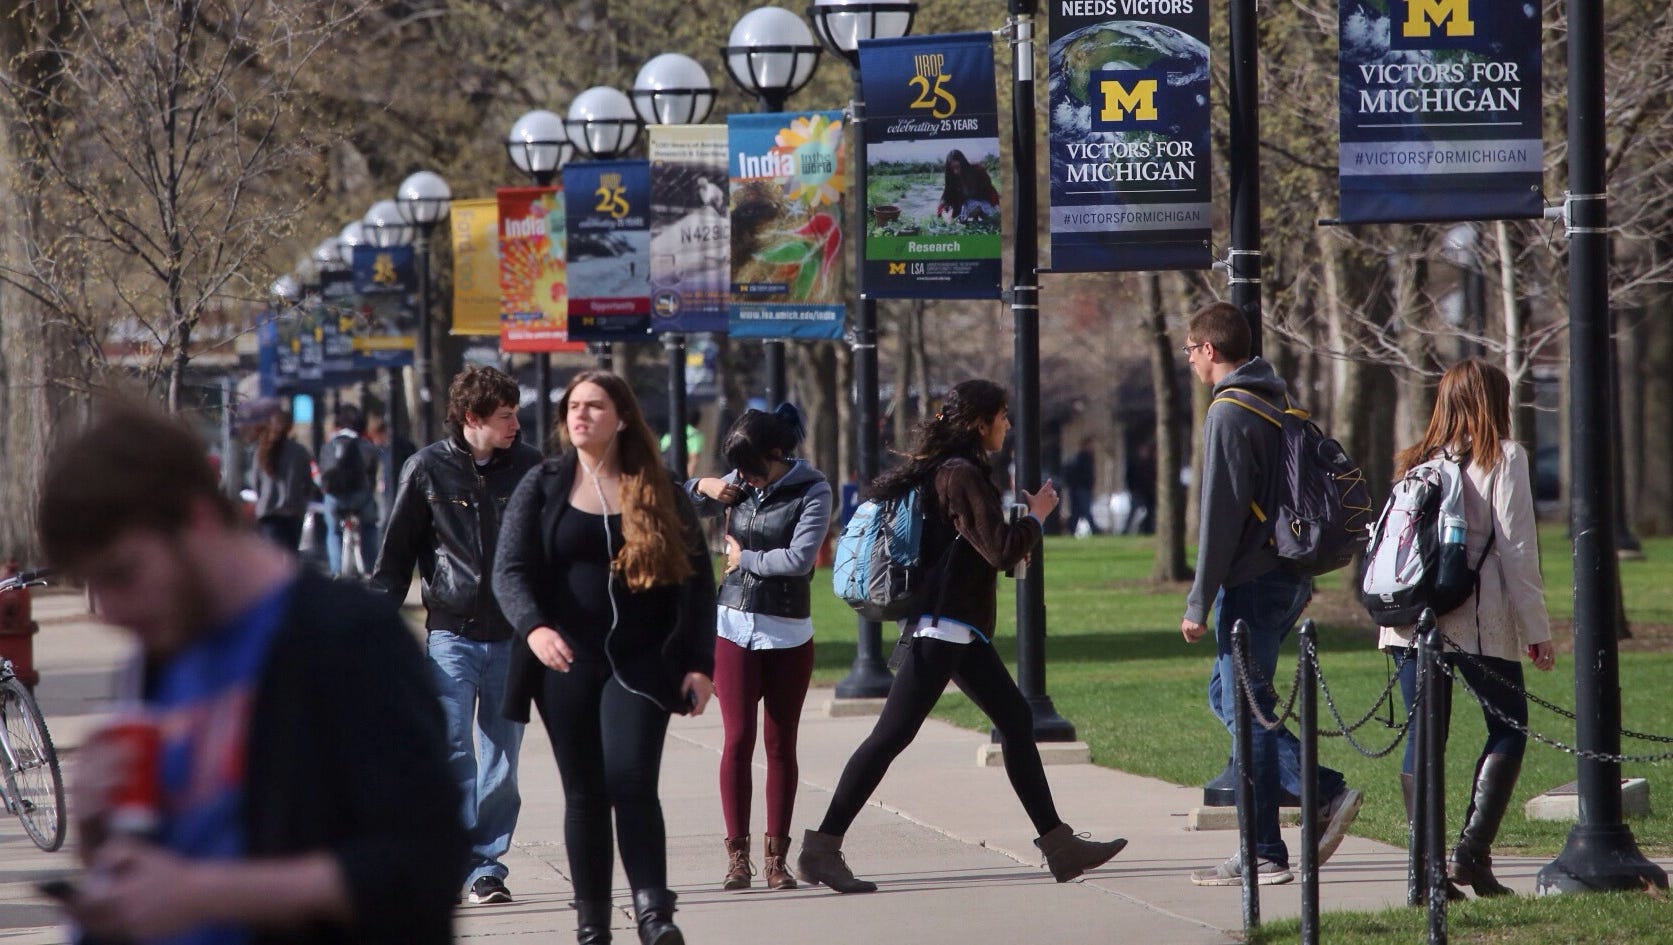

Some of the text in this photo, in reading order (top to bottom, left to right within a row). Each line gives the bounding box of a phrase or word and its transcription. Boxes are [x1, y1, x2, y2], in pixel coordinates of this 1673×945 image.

[1062, 0, 1194, 16] NEEDS VICTORS
[1402, 0, 1474, 37] M
[915, 54, 944, 77] UROP
[1359, 62, 1520, 84] VICTORS FOR
[908, 74, 957, 119] 25
[1101, 79, 1158, 122] M
[1358, 87, 1522, 114] MICHIGAN
[887, 119, 979, 136] celebrating 25 YEARS
[1066, 141, 1195, 159] VICTORS FOR
[1355, 149, 1528, 166] #VICTORSFORMICHIGAN
[738, 151, 794, 179] India
[801, 161, 832, 174] world
[1066, 161, 1196, 183] MICHIGAN
[594, 186, 630, 219] 25
[504, 217, 546, 237] India
[1064, 210, 1201, 226] #VICTORSFORMICHIGAN
[908, 241, 961, 253] Research
[888, 262, 906, 275] M
[911, 262, 925, 275] LSA
